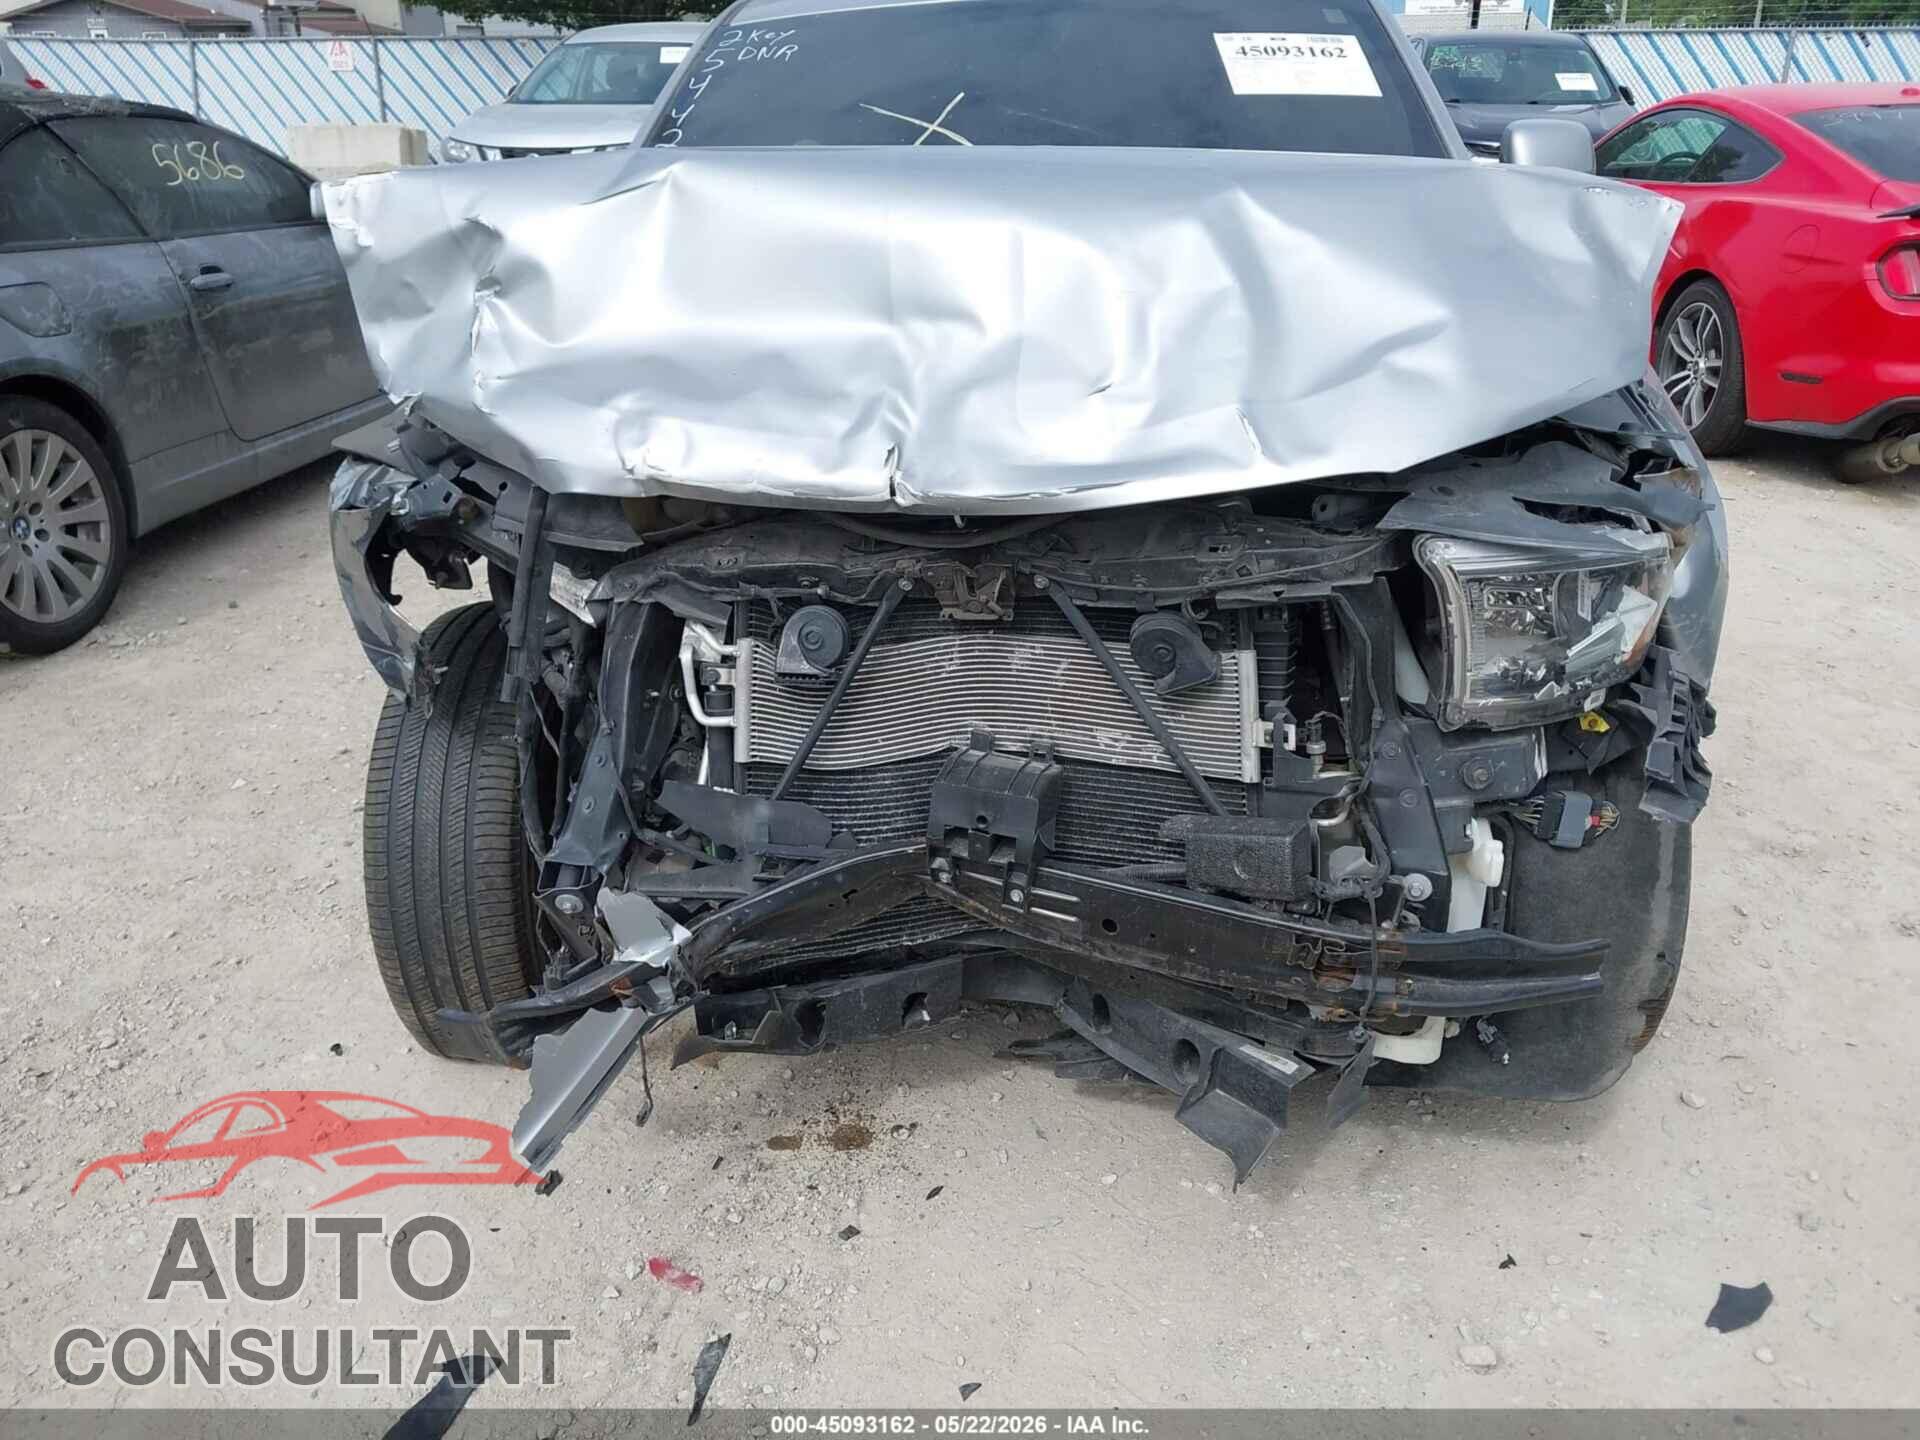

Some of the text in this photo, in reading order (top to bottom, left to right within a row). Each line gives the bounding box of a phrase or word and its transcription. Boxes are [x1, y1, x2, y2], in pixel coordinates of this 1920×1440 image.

[719, 30, 742, 47] 2
[1235, 45, 1348, 58] 45093162
[151, 140, 245, 186] 5686
